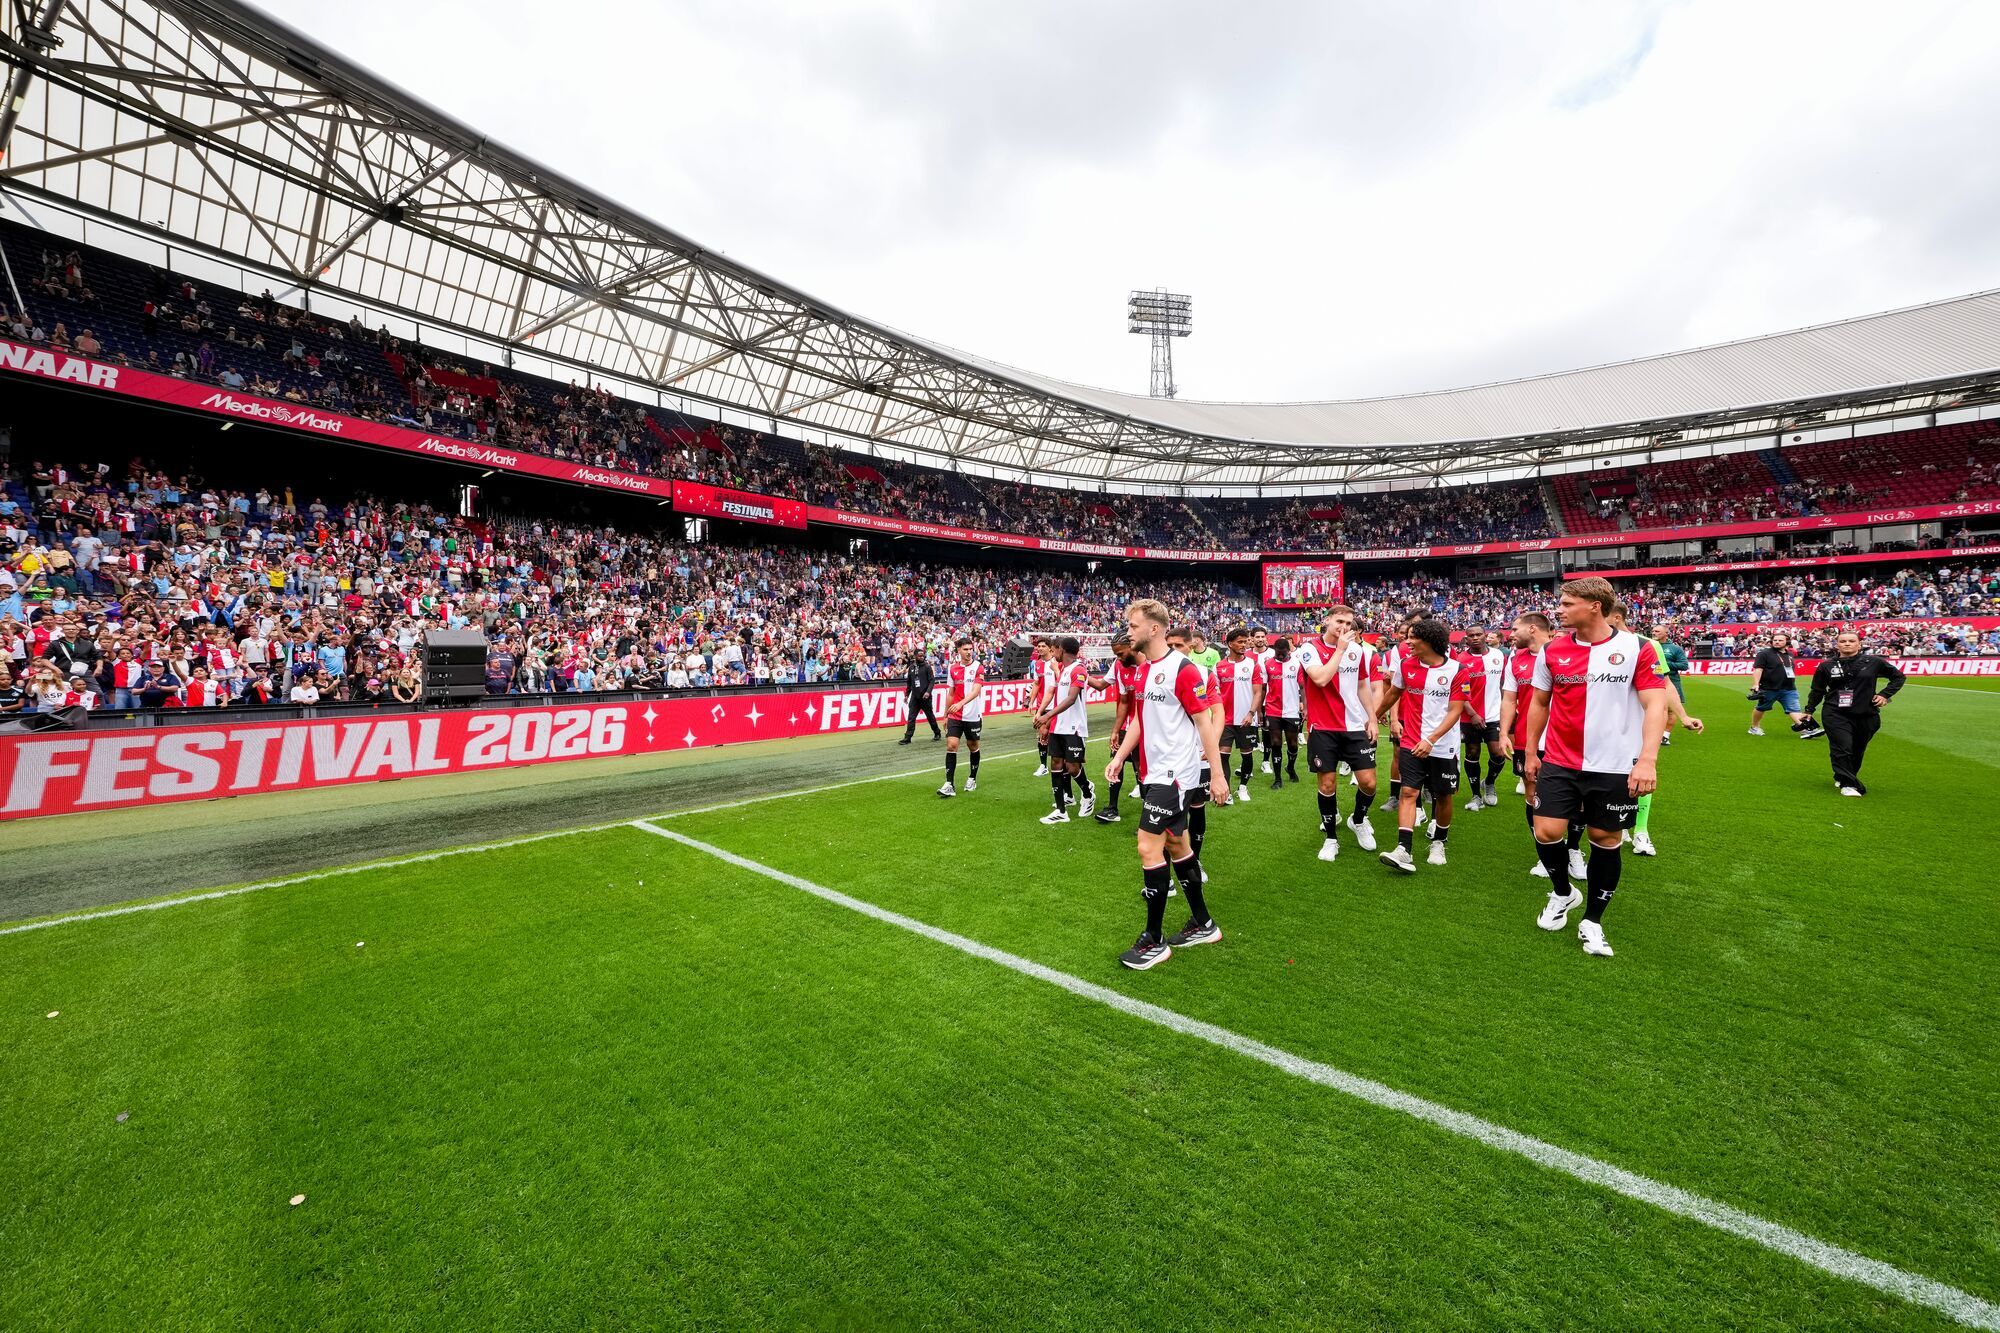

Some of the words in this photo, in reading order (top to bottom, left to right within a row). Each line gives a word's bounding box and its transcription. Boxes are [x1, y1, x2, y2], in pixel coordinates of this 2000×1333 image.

[0, 341, 118, 389] NAAR
[722, 501, 767, 518] FESTIVAL
[1867, 512, 1894, 522] ING
[873, 519, 902, 530] vakanties
[940, 529, 966, 538] vakanties
[1000, 537, 1025, 545] vakanties
[1577, 536, 1625, 544] RIVERDALE
[1039, 539, 1048, 549] 16
[1048, 541, 1067, 551] KEER
[1067, 542, 1126, 556] LANDSKAMPIOEN
[1145, 549, 1180, 560] WINNAAR
[1180, 550, 1198, 560] UEFA
[1199, 551, 1213, 561] CUP
[1213, 552, 1231, 561] 1974
[1232, 552, 1238, 561] &
[1344, 549, 1407, 560] WERELDBEKER
[1408, 548, 1430, 557] 1970
[1888, 659, 2000, 675] YENOORD
[1594, 673, 1629, 683] Markt
[1145, 691, 1166, 702] Markt
[820, 688, 949, 730] FEYENO
[0, 718, 449, 812] FESTIVAL
[462, 707, 627, 766] 2026
[1143, 802, 1173, 816] fairphone
[1606, 803, 1639, 813] fairphon
